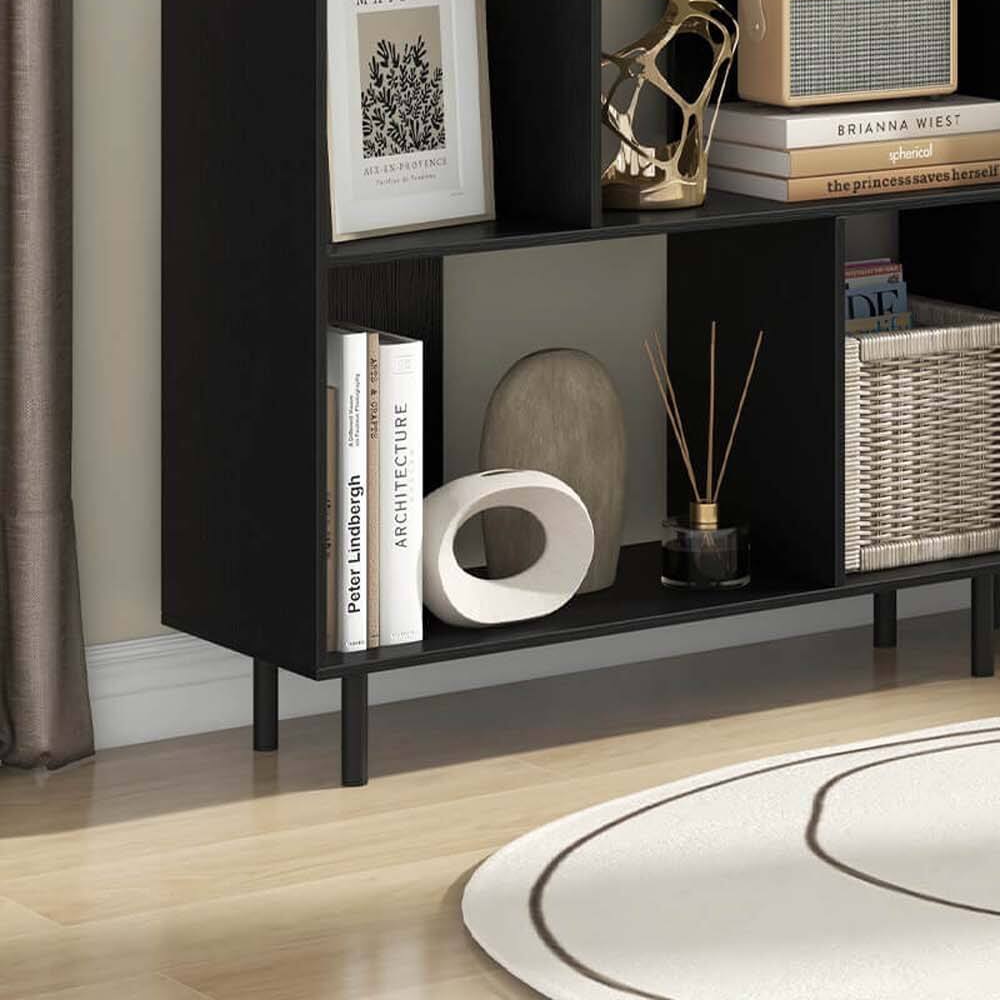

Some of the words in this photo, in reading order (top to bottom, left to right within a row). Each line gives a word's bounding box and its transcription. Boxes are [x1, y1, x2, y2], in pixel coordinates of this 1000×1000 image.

[837, 118, 909, 136] BRIANNA
[916, 114, 961, 130] WIEST
[889, 143, 933, 164] spherical
[828, 180, 850, 194] the
[852, 175, 912, 194] princess
[912, 172, 950, 187] saves
[951, 165, 999, 181] herself
[394, 402, 408, 548] ARCHITECTURE
[347, 474, 364, 564] Lindbergh
[347, 568, 361, 614] Peter
